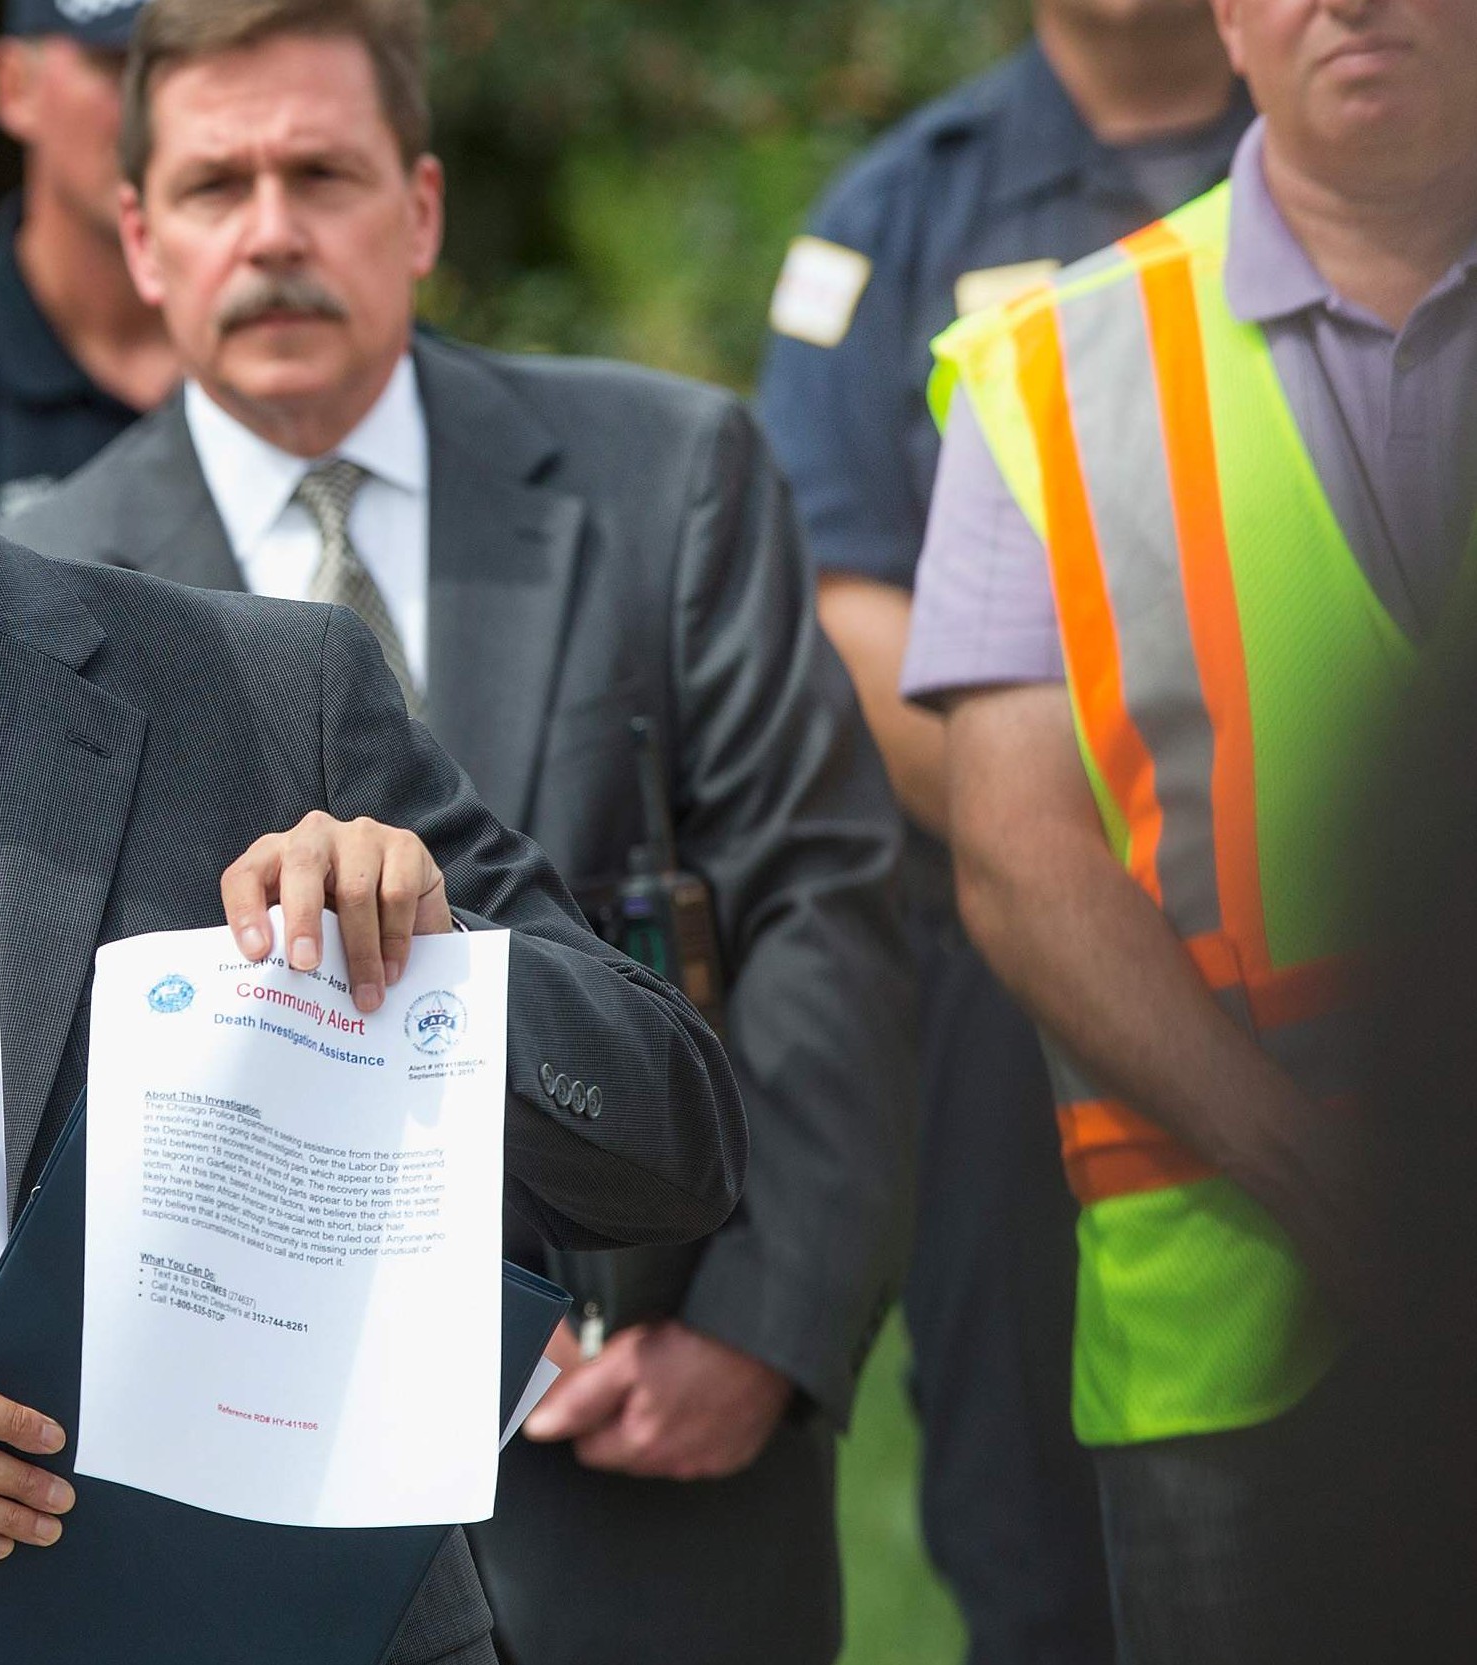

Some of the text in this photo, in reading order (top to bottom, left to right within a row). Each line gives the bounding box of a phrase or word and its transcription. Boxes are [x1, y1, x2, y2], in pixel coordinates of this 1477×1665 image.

[328, 975, 347, 993] Area
[237, 983, 325, 1026] Community
[328, 1009, 365, 1036] Alert
[214, 1013, 385, 1067] Death Investigation Assistance
[144, 1090, 177, 1102] About
[179, 1091, 202, 1103] This
[208, 1107, 236, 1121] Police
[348, 1149, 372, 1160] from
[374, 1151, 389, 1160] the
[162, 1124, 218, 1142] Department
[310, 1167, 335, 1180] which
[337, 1173, 372, 1185] appear
[373, 1175, 384, 1184] to
[386, 1175, 399, 1184] be
[308, 1154, 329, 1167] Over
[330, 1158, 346, 1170] the
[348, 1161, 377, 1172] Labor
[379, 1162, 399, 1174] Day
[178, 1163, 191, 1174] At
[307, 1205, 321, 1215] we
[322, 1206, 358, 1220] believe
[359, 1210, 376, 1220] the
[308, 1178, 325, 1191] The
[326, 1184, 369, 1198] recovery
[370, 1188, 392, 1196] was
[308, 1193, 341, 1205] appear
[342, 1197, 353, 1207] to
[354, 1198, 369, 1208] be
[370, 1198, 393, 1208] from
[306, 1216, 326, 1229] with
[357, 1222, 384, 1232] black
[291, 1227, 320, 1240] cannot
[322, 1230, 335, 1241] be
[336, 1233, 362, 1244] ruled
[287, 1250, 304, 1262] and
[305, 1254, 334, 1267] report
[309, 1241, 348, 1258] missing
[348, 1246, 379, 1257] under
[139, 1252, 165, 1267] What
[167, 1256, 186, 1271] You
[186, 1262, 203, 1276] Can
[199, 1280, 228, 1298] CRIMES
[169, 1284, 189, 1298] Area
[251, 1311, 309, 1334] 312-744-8261
[217, 1402, 252, 1421] Reference
